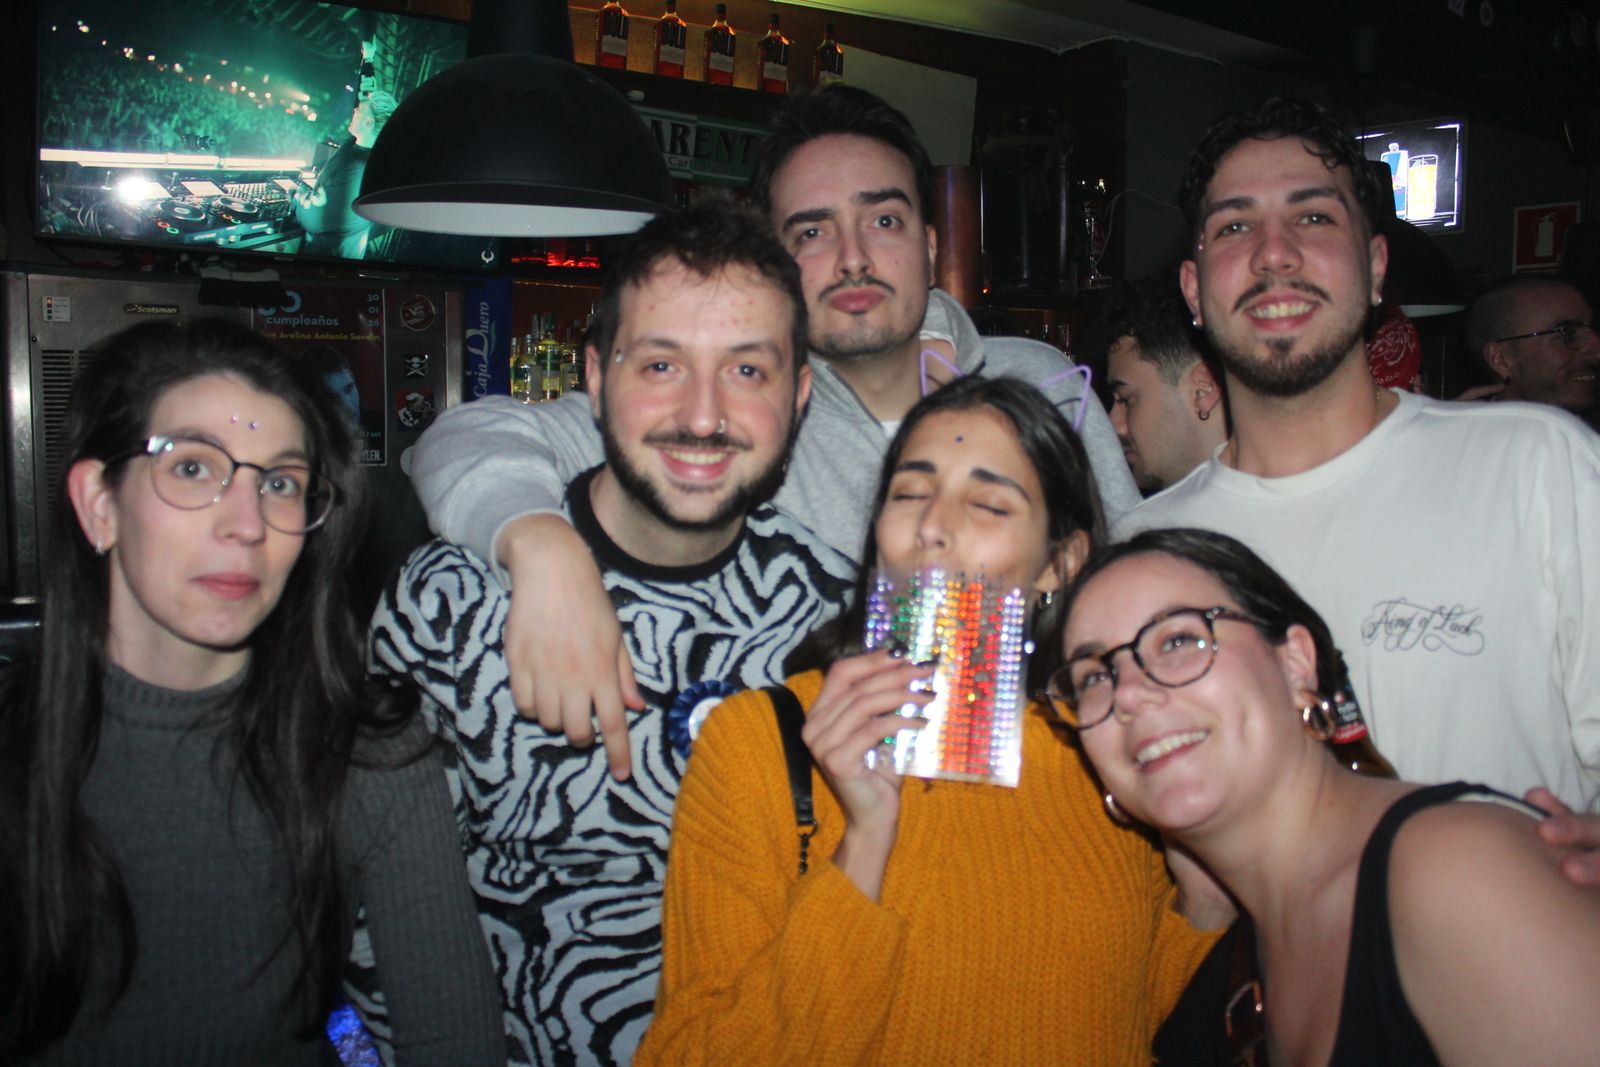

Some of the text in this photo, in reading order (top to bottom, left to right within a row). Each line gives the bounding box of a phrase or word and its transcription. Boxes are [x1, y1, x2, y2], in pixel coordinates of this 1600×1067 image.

[137, 305, 177, 314] Scotsman
[266, 314, 339, 328] cumpleaños
[314, 332, 348, 341] Antonio
